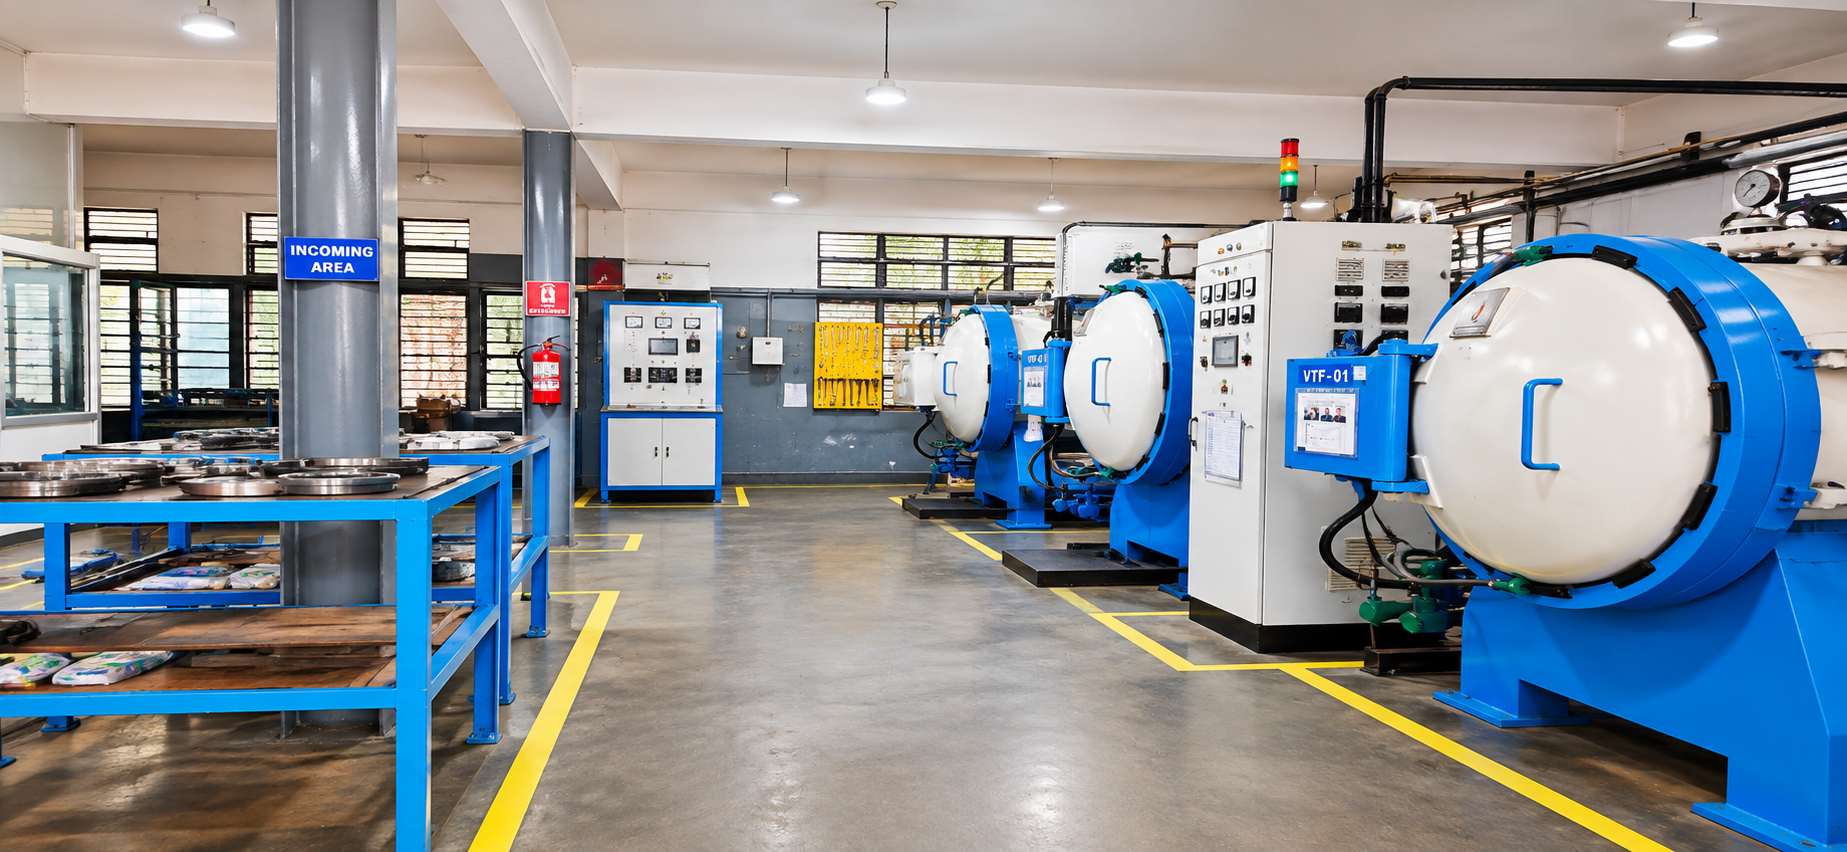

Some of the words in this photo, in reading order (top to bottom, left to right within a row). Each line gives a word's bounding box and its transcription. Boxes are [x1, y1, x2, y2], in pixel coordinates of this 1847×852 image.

[290, 244, 374, 258] INCOMING
[310, 261, 355, 274] AREA
[1303, 369, 1349, 383] VTF-01
